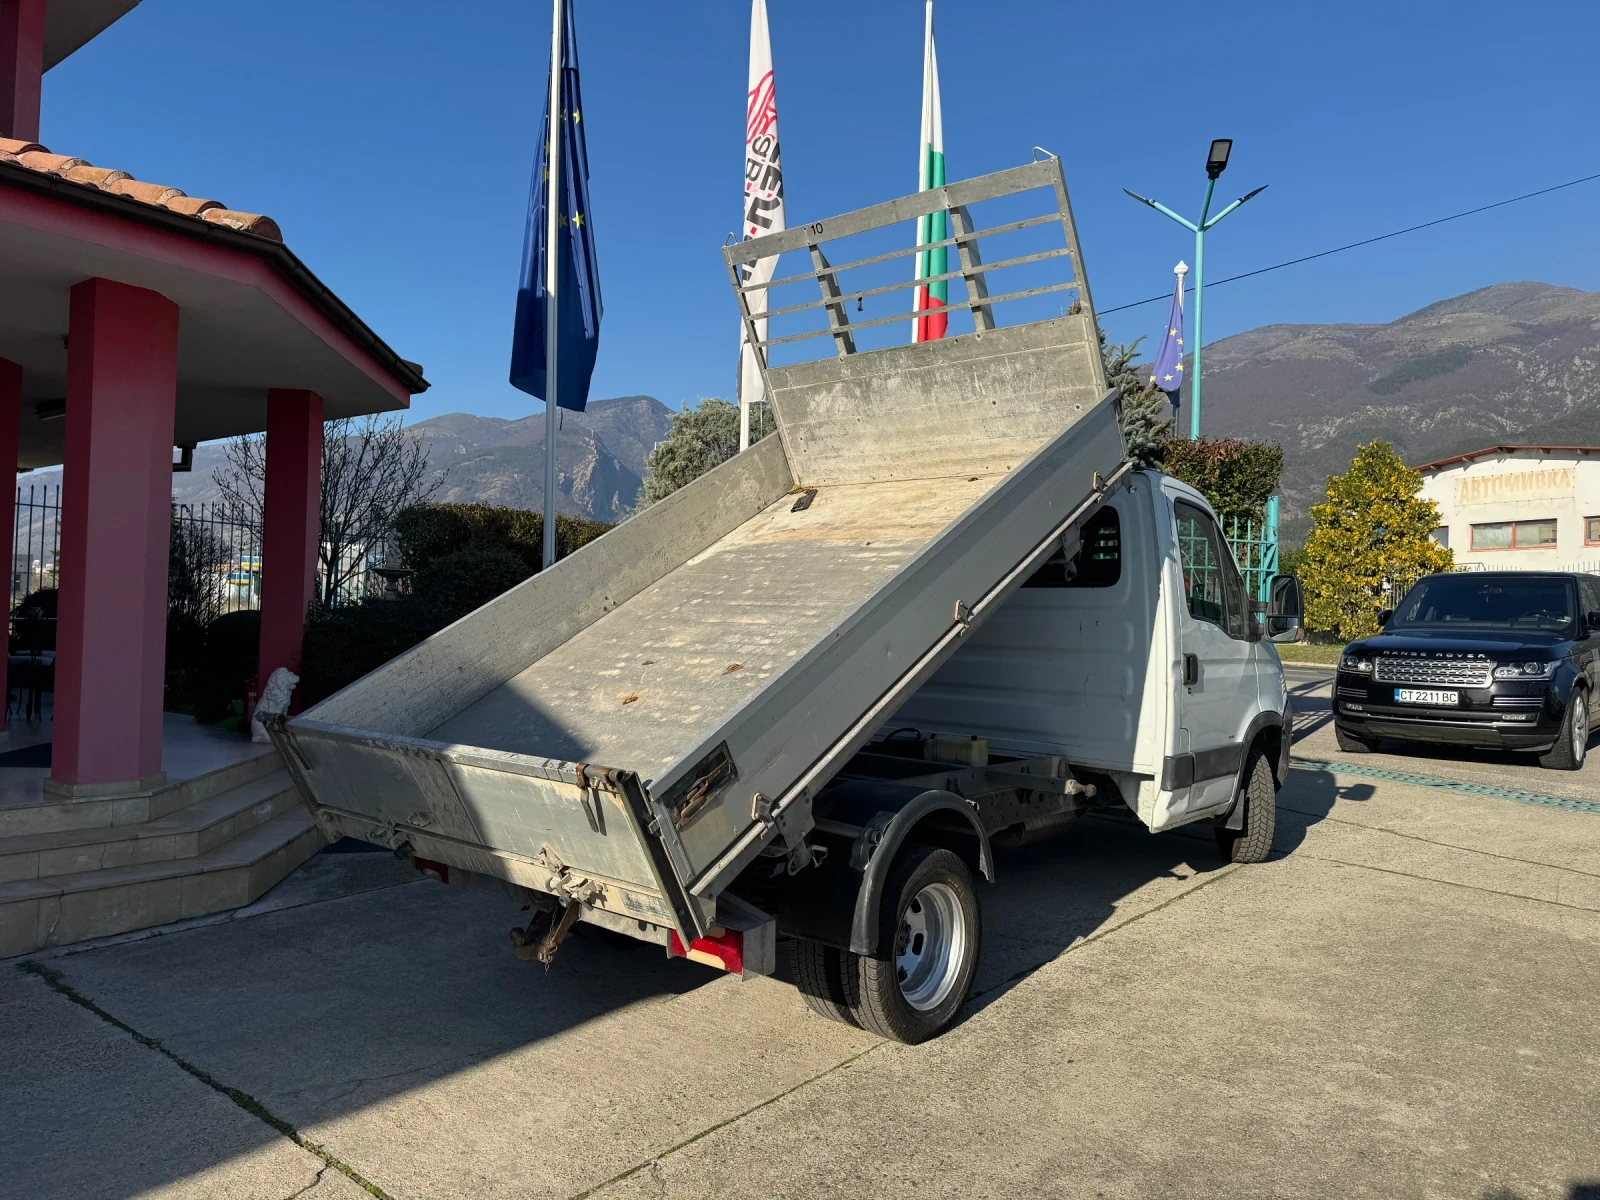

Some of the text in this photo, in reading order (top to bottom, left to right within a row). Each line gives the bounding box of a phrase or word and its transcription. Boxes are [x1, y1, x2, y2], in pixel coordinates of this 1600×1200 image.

[811, 223, 824, 235] 10
[1460, 470, 1571, 504] АВТОМИВКА
[1400, 690, 1457, 702] CT 2211 BC
